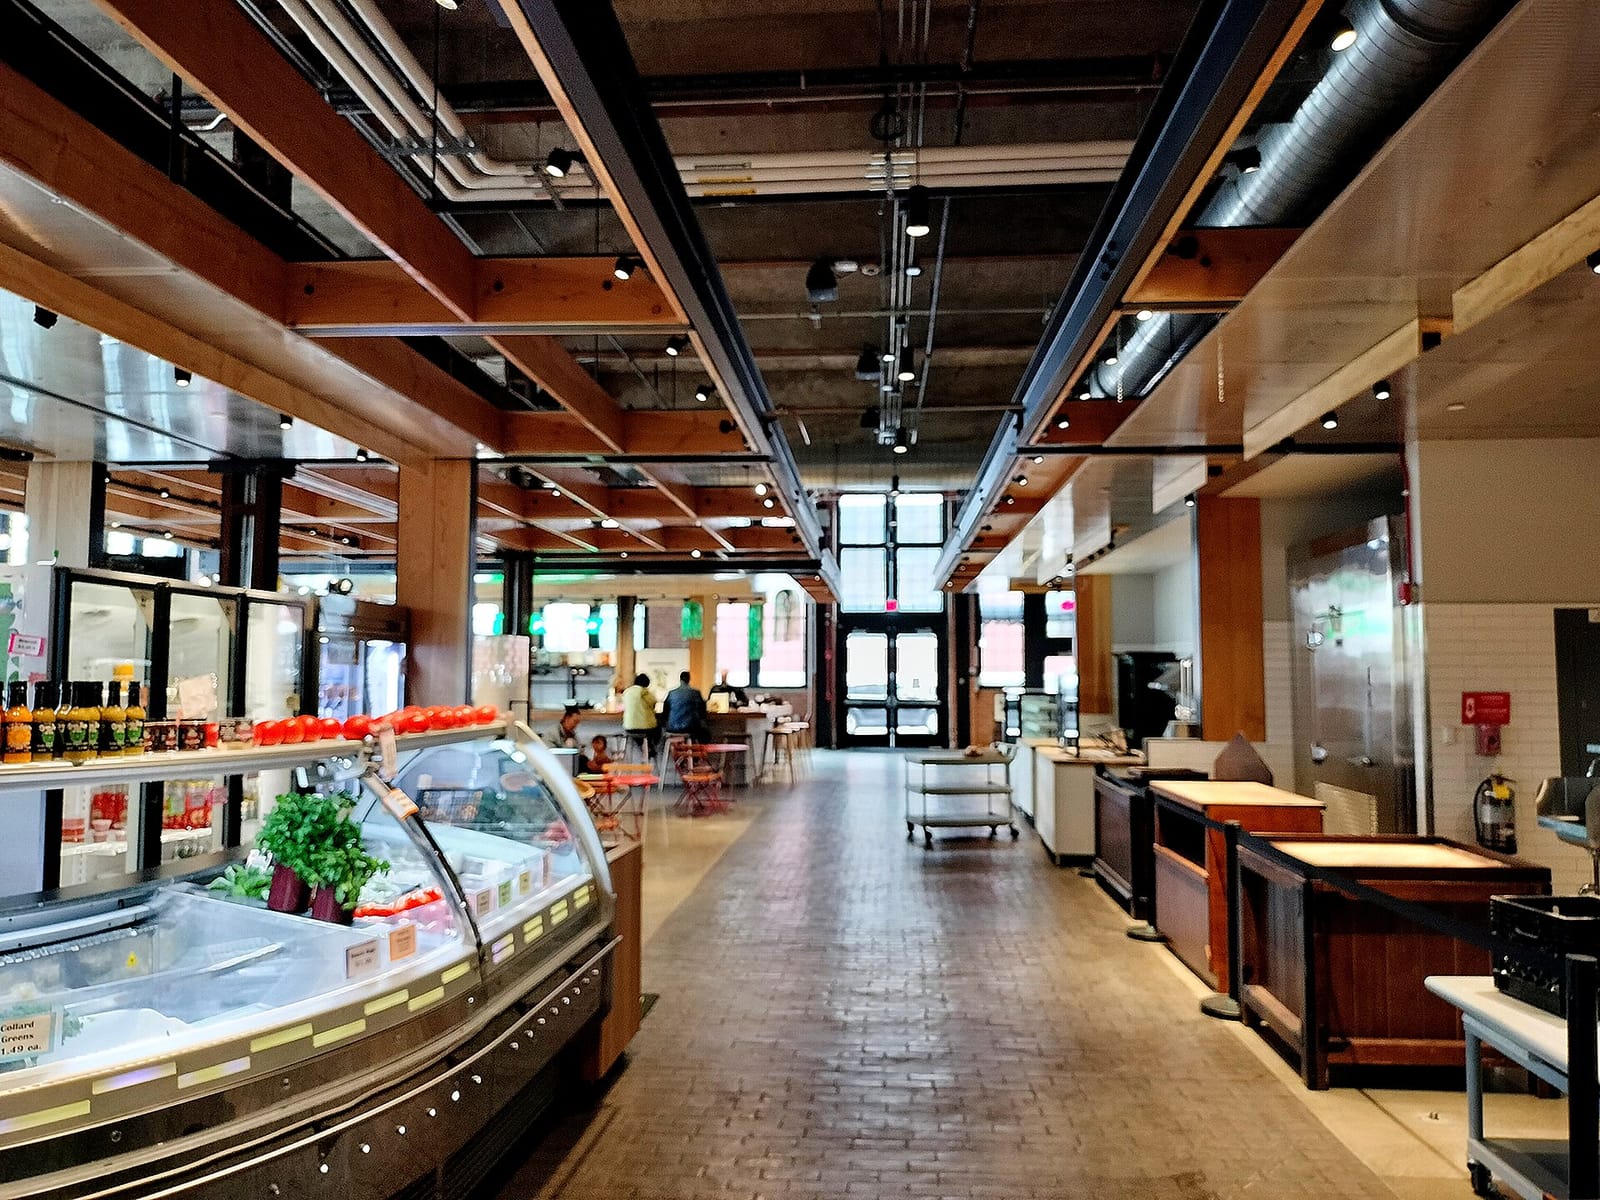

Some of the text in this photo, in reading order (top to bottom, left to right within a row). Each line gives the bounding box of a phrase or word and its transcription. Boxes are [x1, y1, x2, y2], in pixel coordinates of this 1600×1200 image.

[0, 1021, 34, 1032] Collard
[1, 1033, 34, 1043] Greens
[1, 1045, 23, 1055] 1.49
